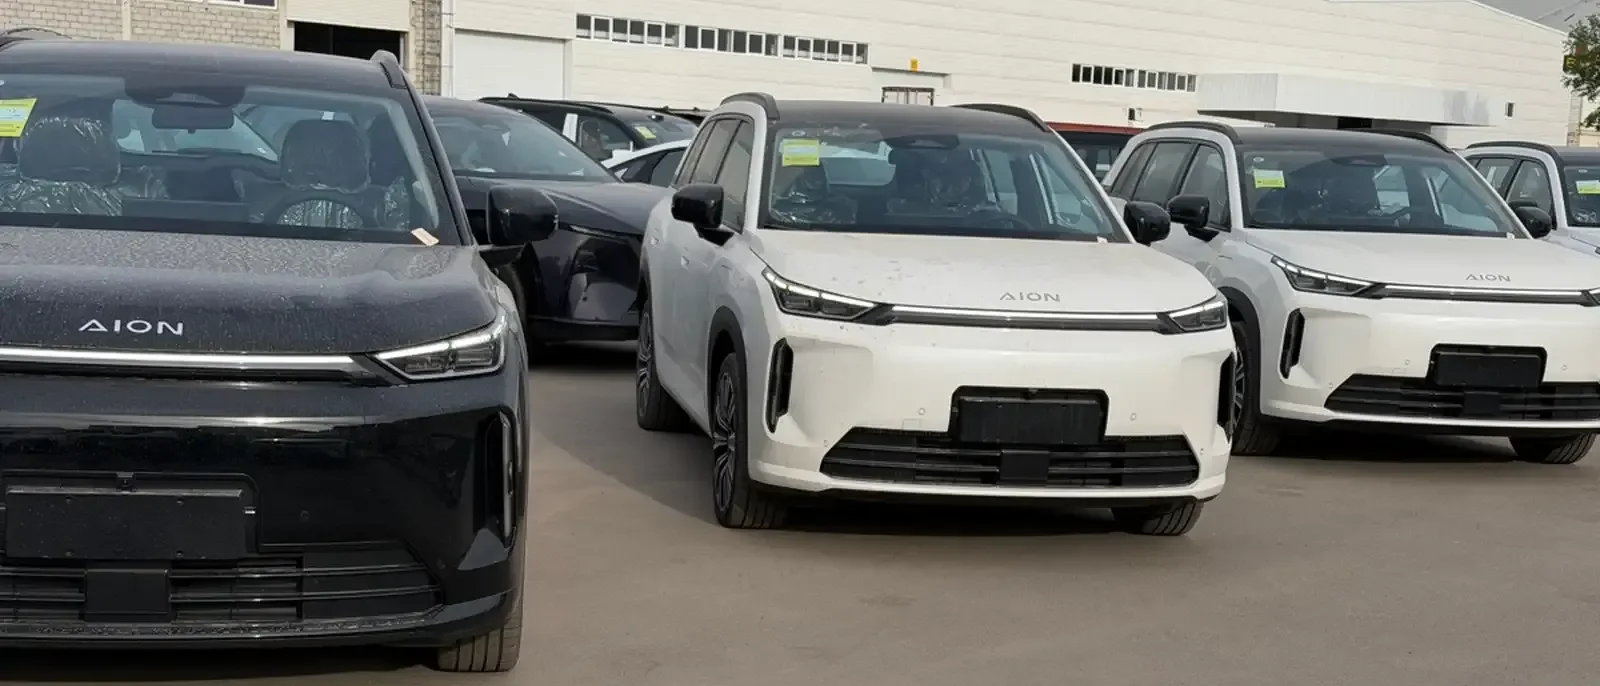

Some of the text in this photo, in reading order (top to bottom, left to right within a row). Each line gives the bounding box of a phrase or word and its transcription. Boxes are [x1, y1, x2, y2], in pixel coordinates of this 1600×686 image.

[1465, 273, 1511, 282] AION
[1000, 292, 1061, 302] AION
[79, 319, 183, 336] AION
